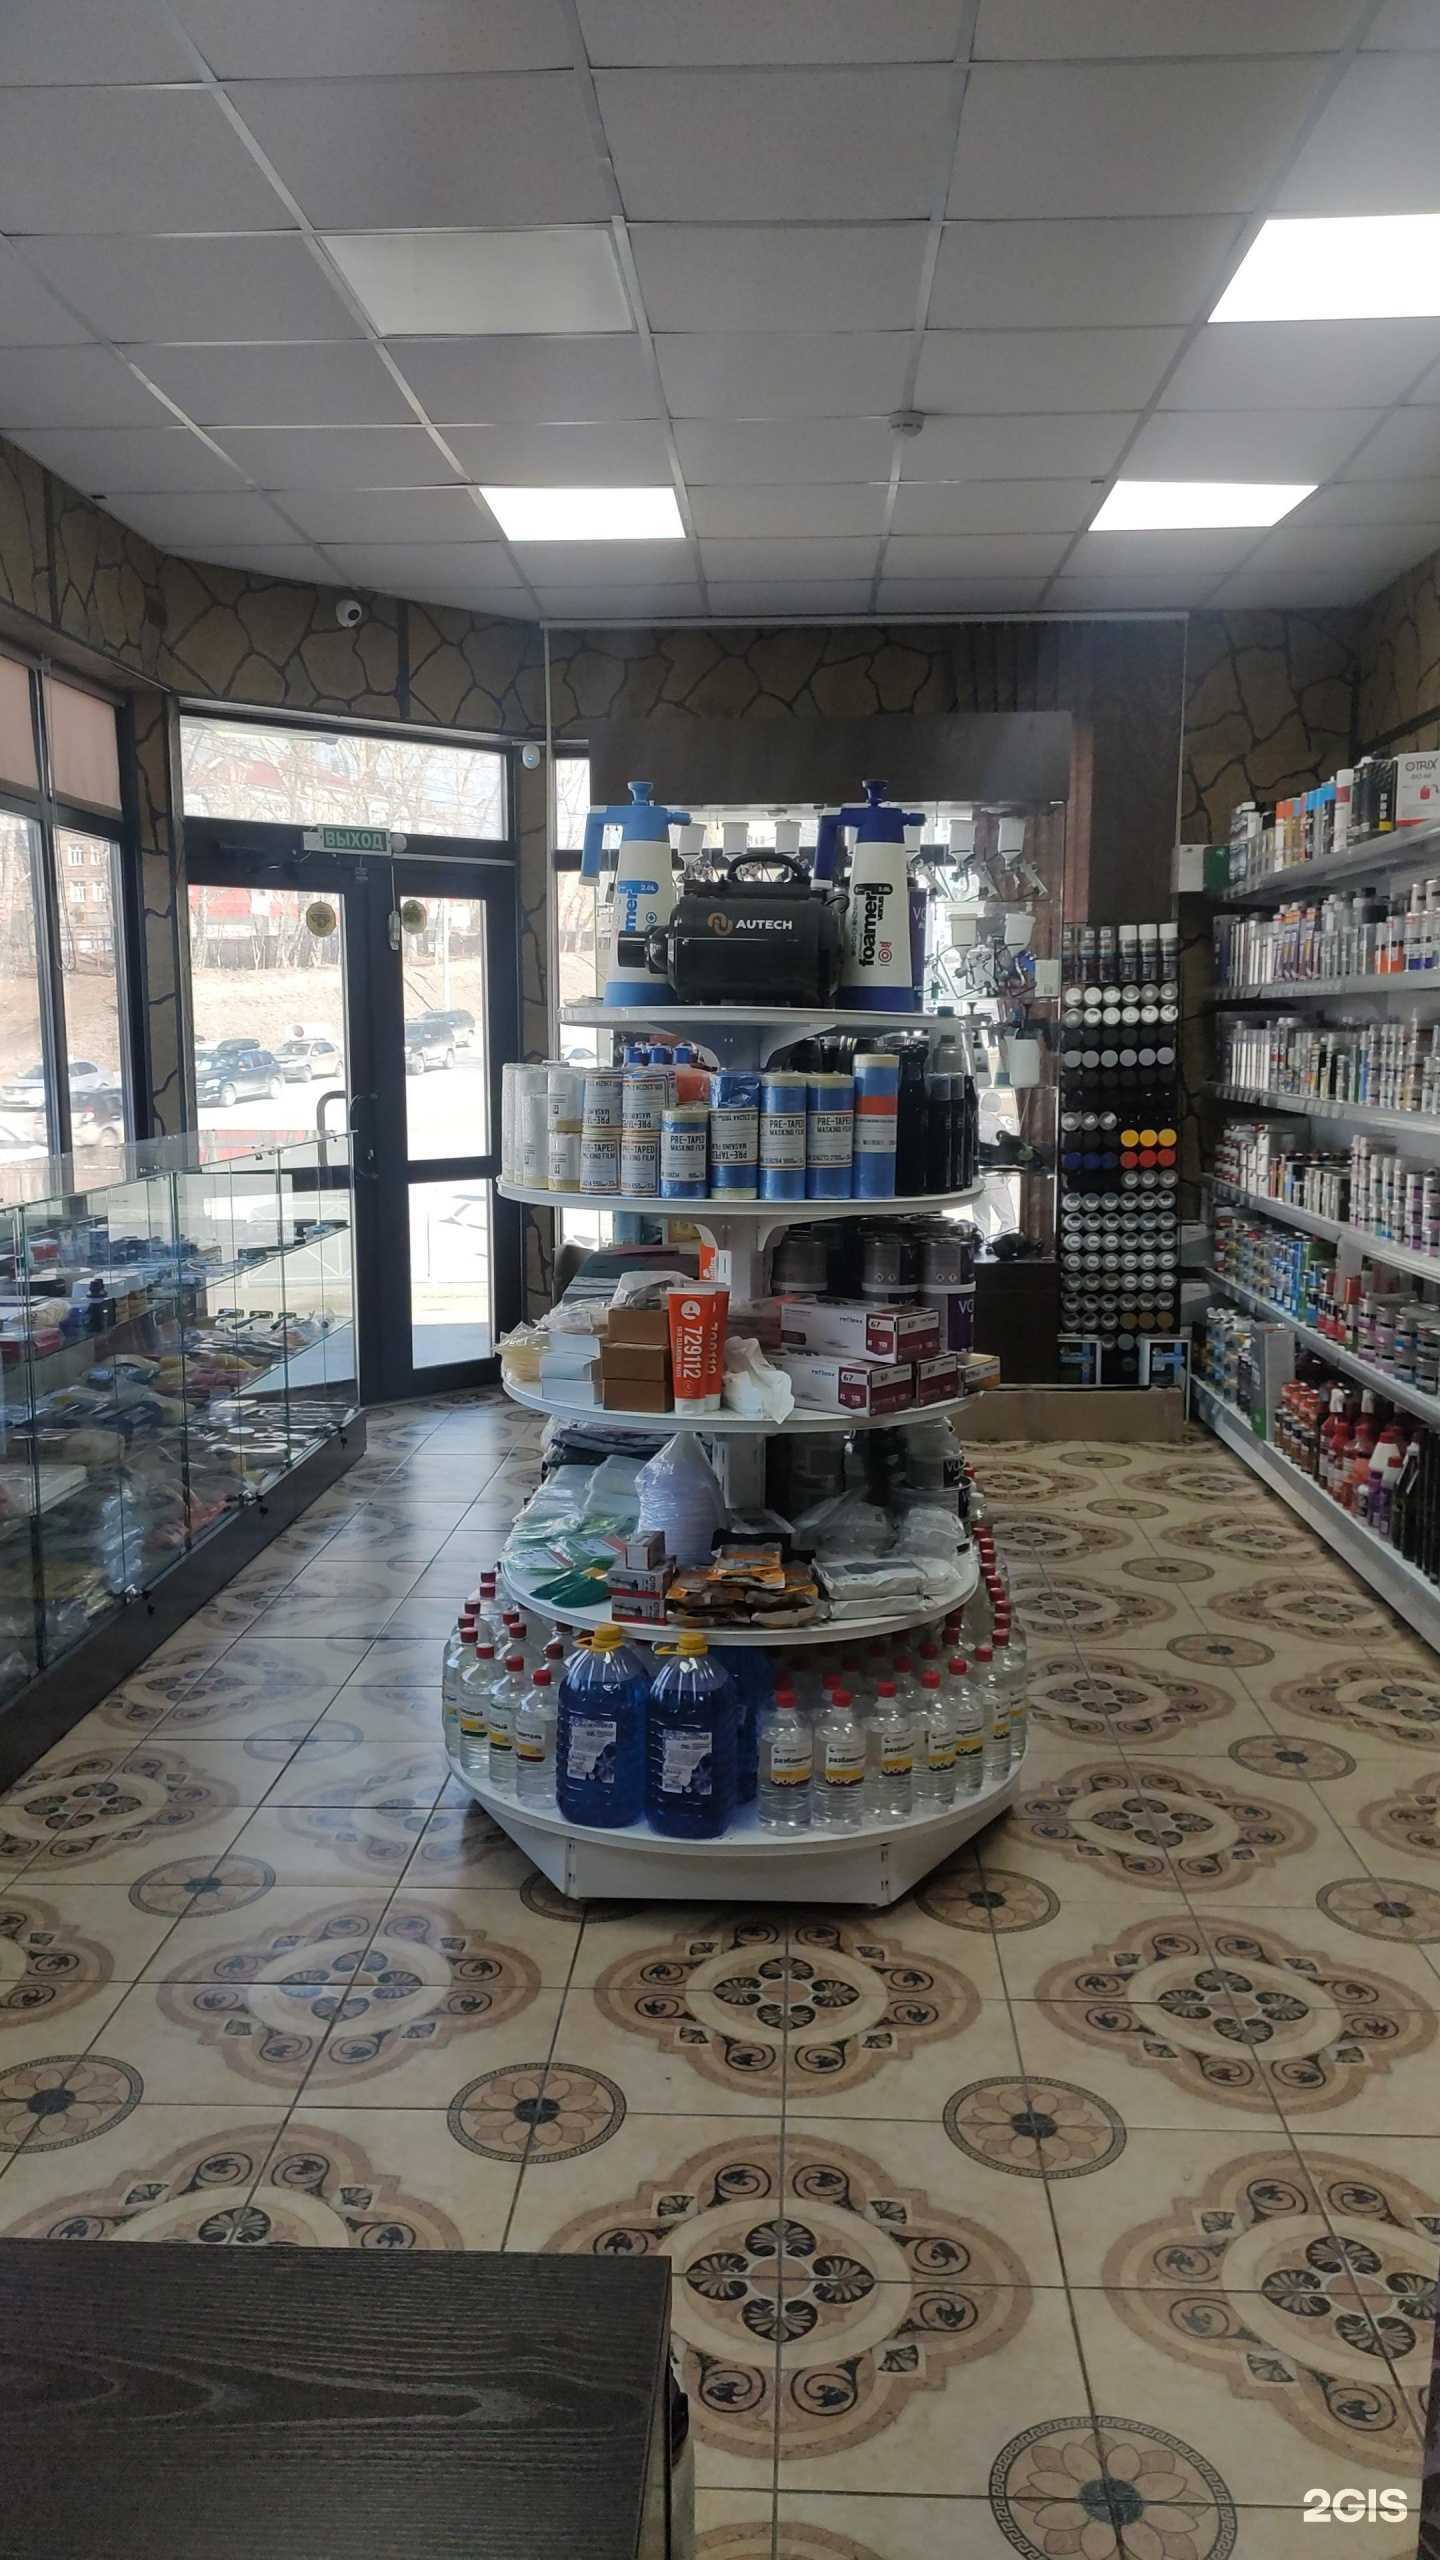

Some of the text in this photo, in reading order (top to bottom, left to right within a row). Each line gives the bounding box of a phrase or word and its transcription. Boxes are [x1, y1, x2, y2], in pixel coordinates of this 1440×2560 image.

[324, 830, 385, 851] ВЫХОД
[735, 919, 793, 931] AUTECH
[859, 892, 877, 968] foamer
[683, 1325, 703, 1379] 729112
